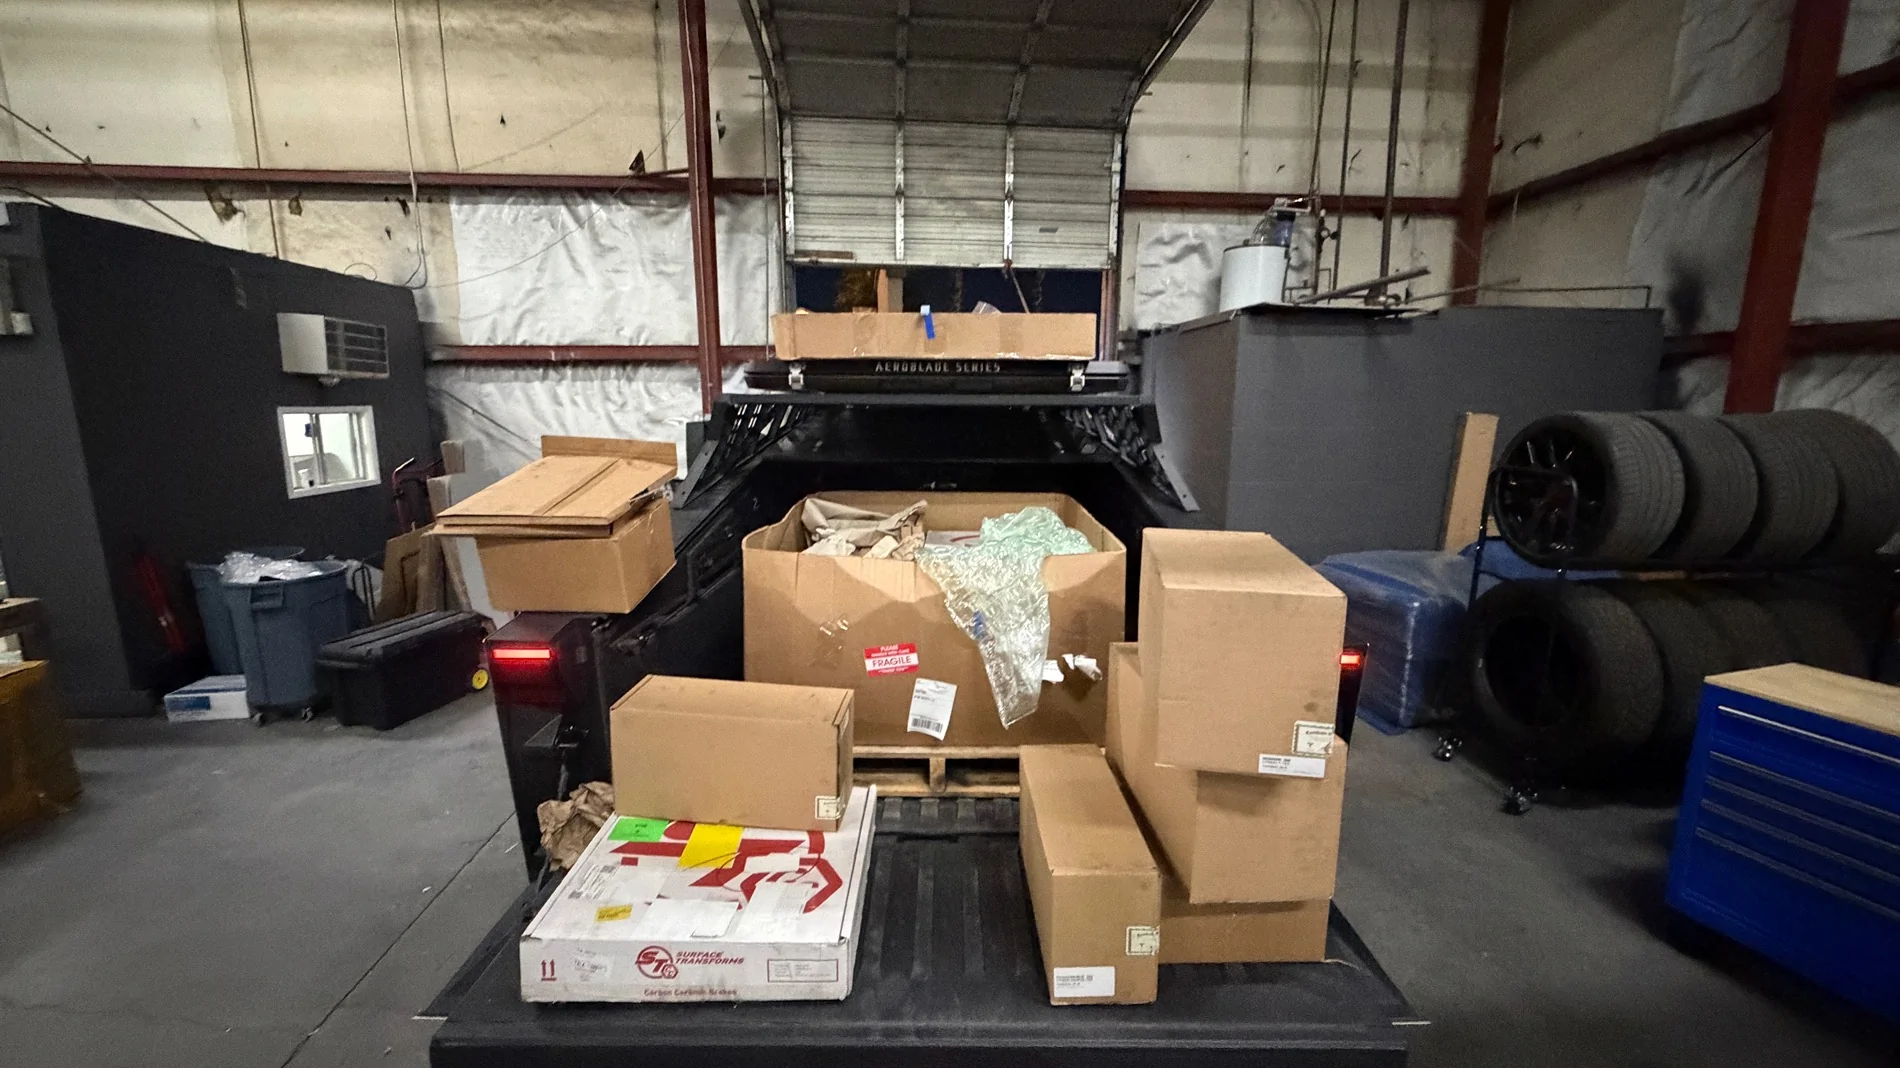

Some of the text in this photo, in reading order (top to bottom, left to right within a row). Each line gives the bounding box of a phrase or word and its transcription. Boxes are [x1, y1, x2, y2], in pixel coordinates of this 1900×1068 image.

[875, 361, 1001, 373] AEROBLADE SERIES
[872, 656, 912, 668] FRAGILE
[675, 957, 745, 965] TRANSFORMS
